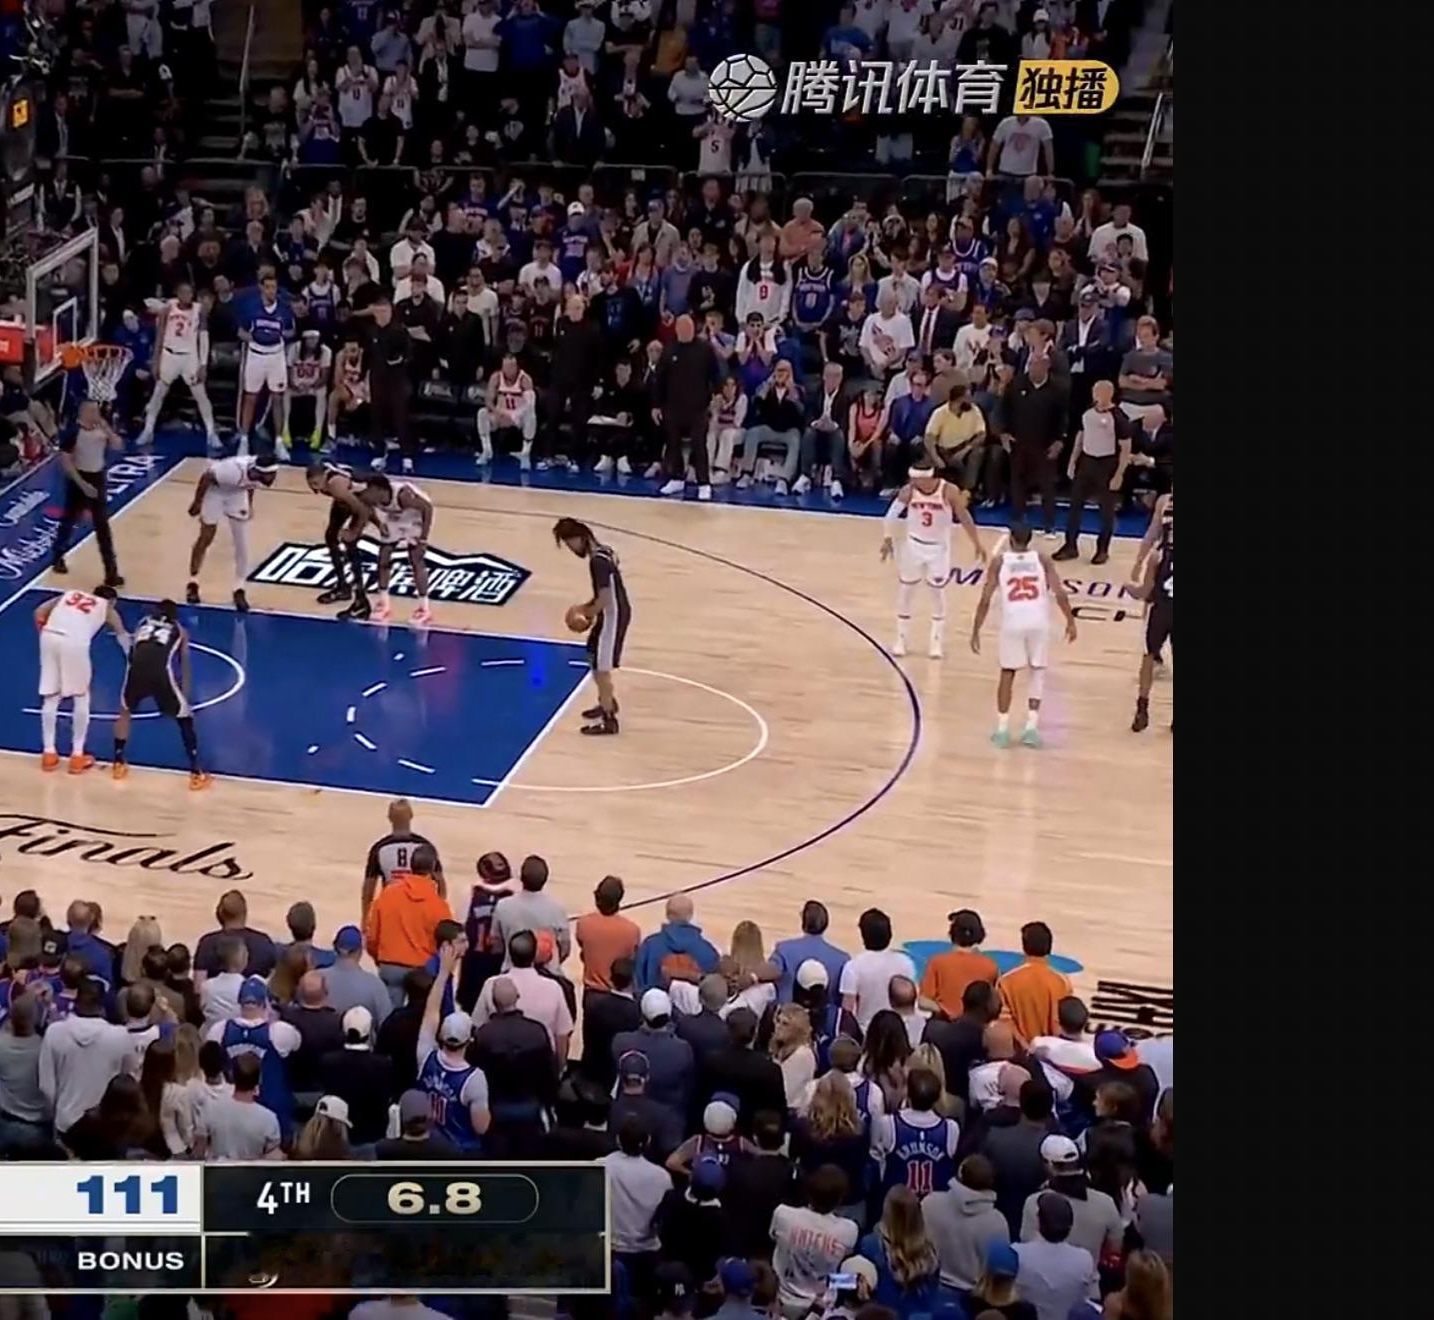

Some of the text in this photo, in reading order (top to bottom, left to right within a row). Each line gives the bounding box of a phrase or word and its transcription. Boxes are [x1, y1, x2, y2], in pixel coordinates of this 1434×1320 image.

[106, 454, 166, 502] LTRA
[921, 511, 933, 528] 3
[1006, 576, 1040, 602] 25
[907, 1160, 933, 1194] 11
